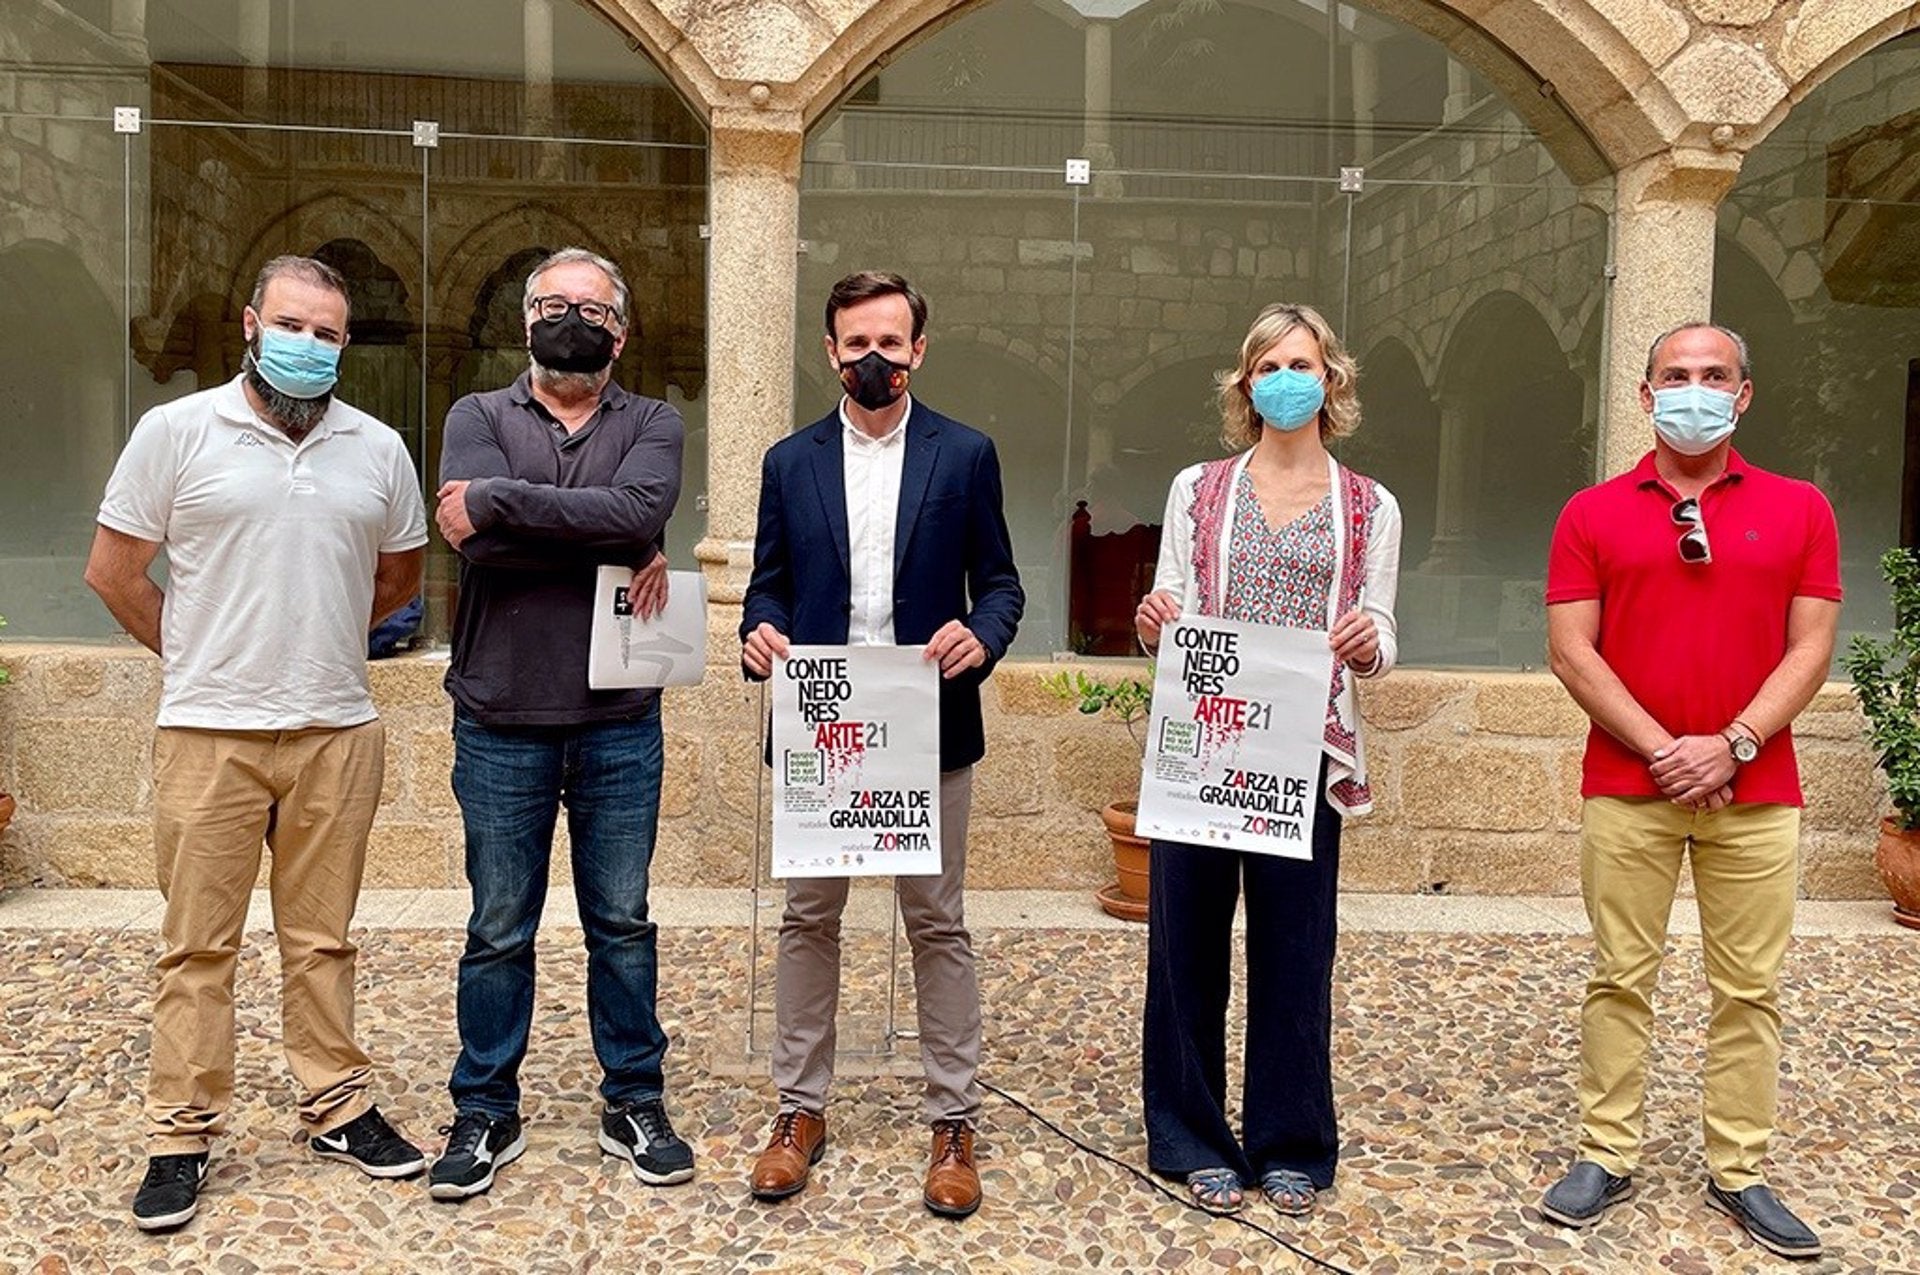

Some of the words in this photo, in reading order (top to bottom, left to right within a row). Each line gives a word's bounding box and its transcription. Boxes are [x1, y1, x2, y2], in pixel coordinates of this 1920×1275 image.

[1175, 627, 1238, 654] CONTE
[786, 658, 846, 680] CONTE
[1182, 650, 1240, 680] NEDO
[798, 681, 852, 709] NEDO
[1186, 675, 1224, 696] RES
[804, 702, 840, 722] RES
[1194, 696, 1248, 727] ARTE
[1248, 702, 1272, 730] 21
[814, 722, 864, 750] ARTE
[866, 722, 888, 748] 21
[1222, 768, 1278, 794] ZARZA
[1283, 778, 1308, 798] DE
[850, 790, 904, 808] ZARZA
[908, 790, 930, 808] DE
[1199, 785, 1304, 818] GRANADILLA
[830, 810, 930, 828] GRANADILLA
[1241, 815, 1302, 841] ZORITA
[873, 833, 930, 851] ZORITA
